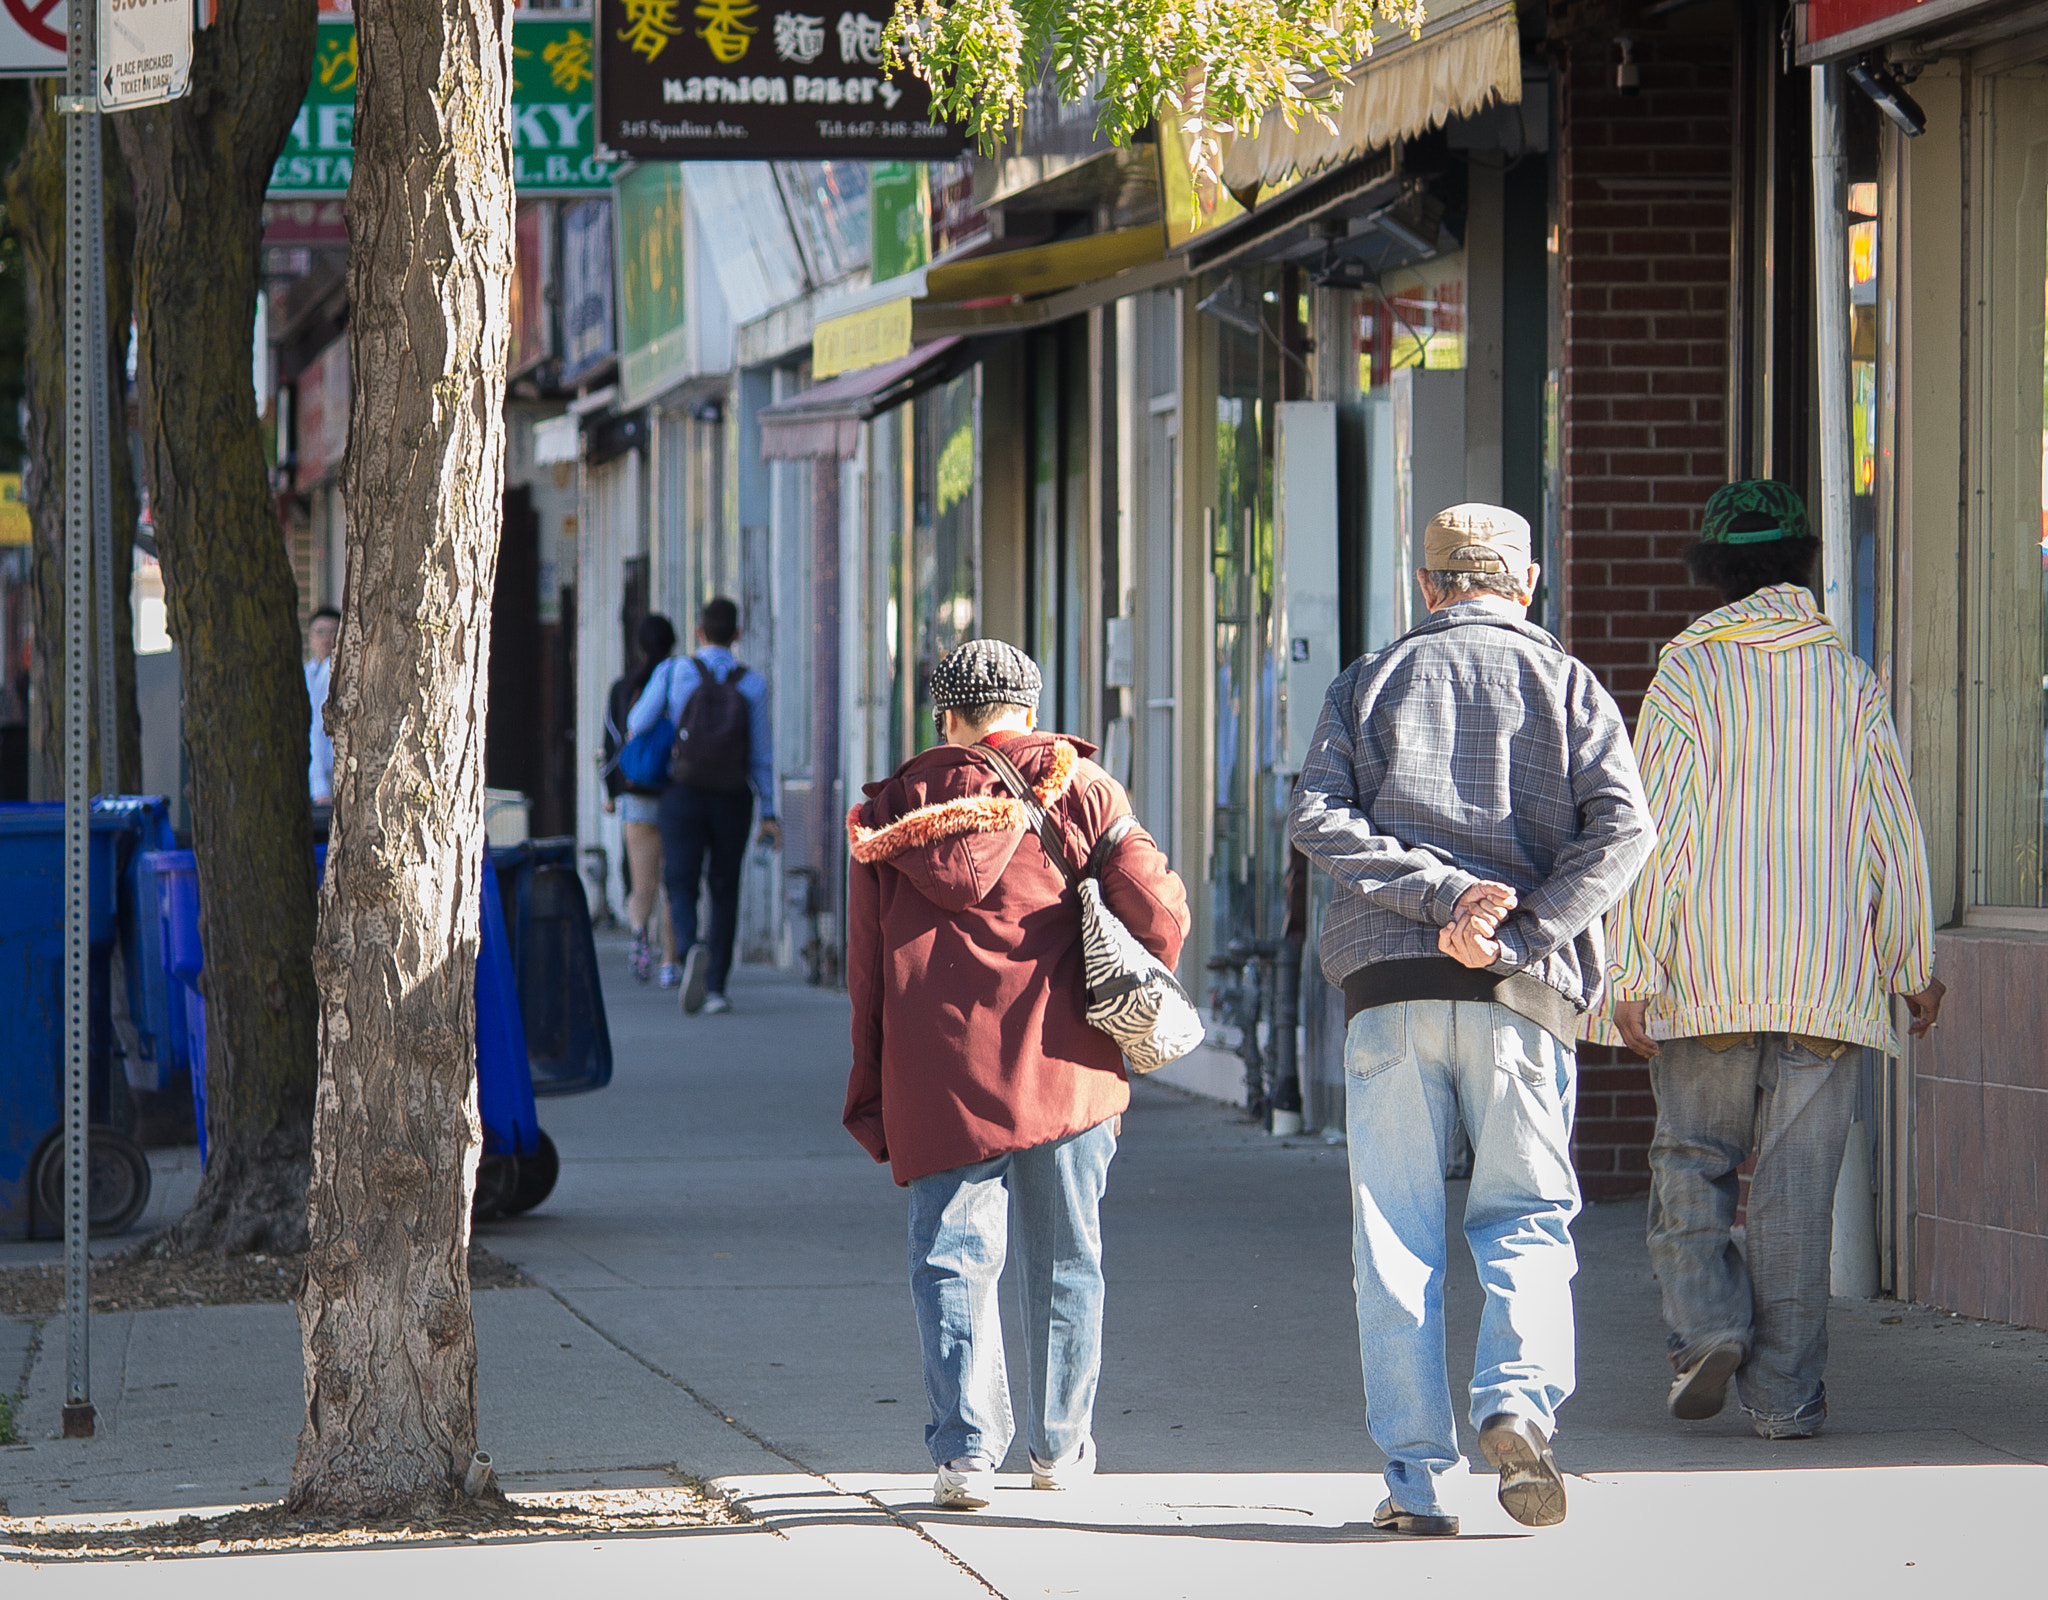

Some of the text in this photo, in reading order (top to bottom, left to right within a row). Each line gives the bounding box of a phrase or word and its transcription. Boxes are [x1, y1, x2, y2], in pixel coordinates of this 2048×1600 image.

[116, 54, 174, 77] PLACE PURCHASED
[120, 78, 142, 95] TICKET
[649, 119, 712, 143] Spadina
